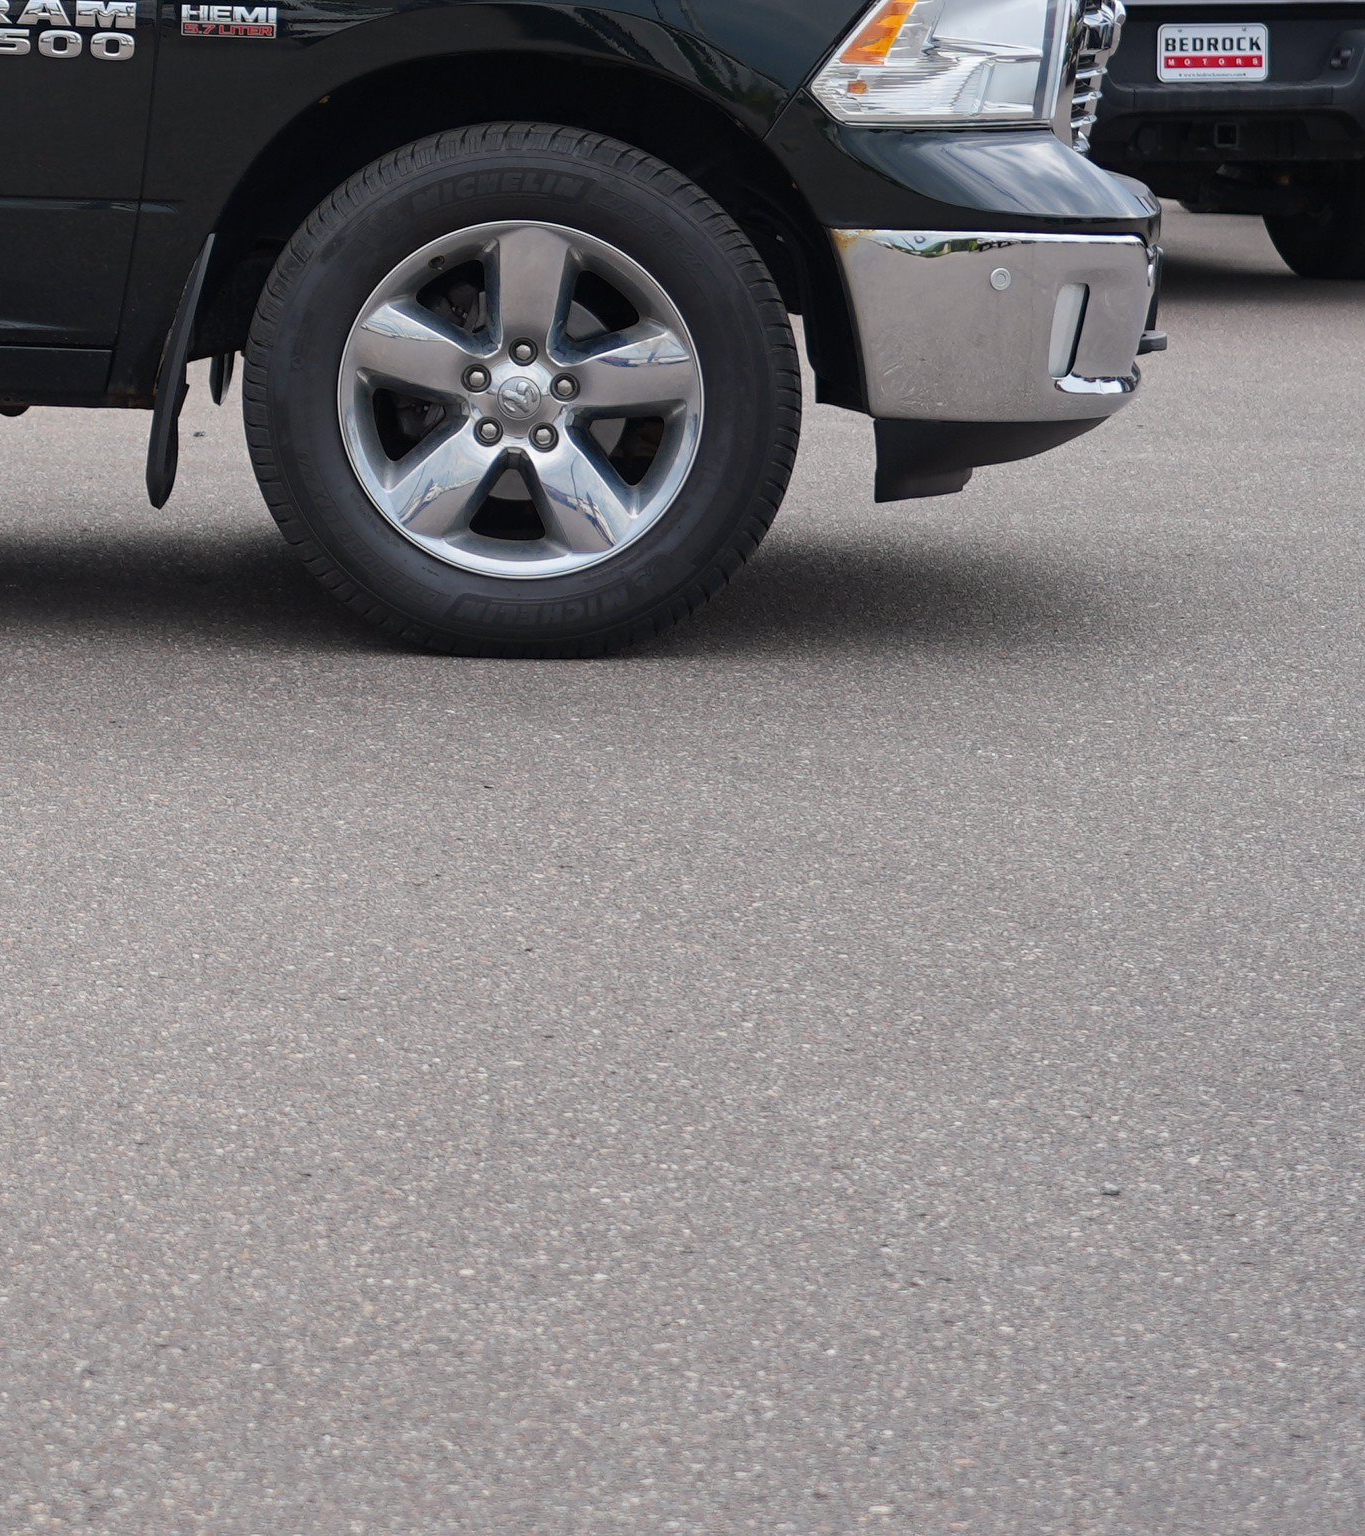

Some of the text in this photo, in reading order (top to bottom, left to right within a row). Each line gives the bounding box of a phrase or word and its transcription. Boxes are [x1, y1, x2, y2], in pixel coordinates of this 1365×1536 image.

[181, 4, 278, 24] HEMI
[183, 23, 275, 37] 5.7 LITER
[1164, 36, 1263, 53] BEDROCK
[1167, 57, 1261, 67] MOTORS
[412, 171, 586, 209] MICHELIN
